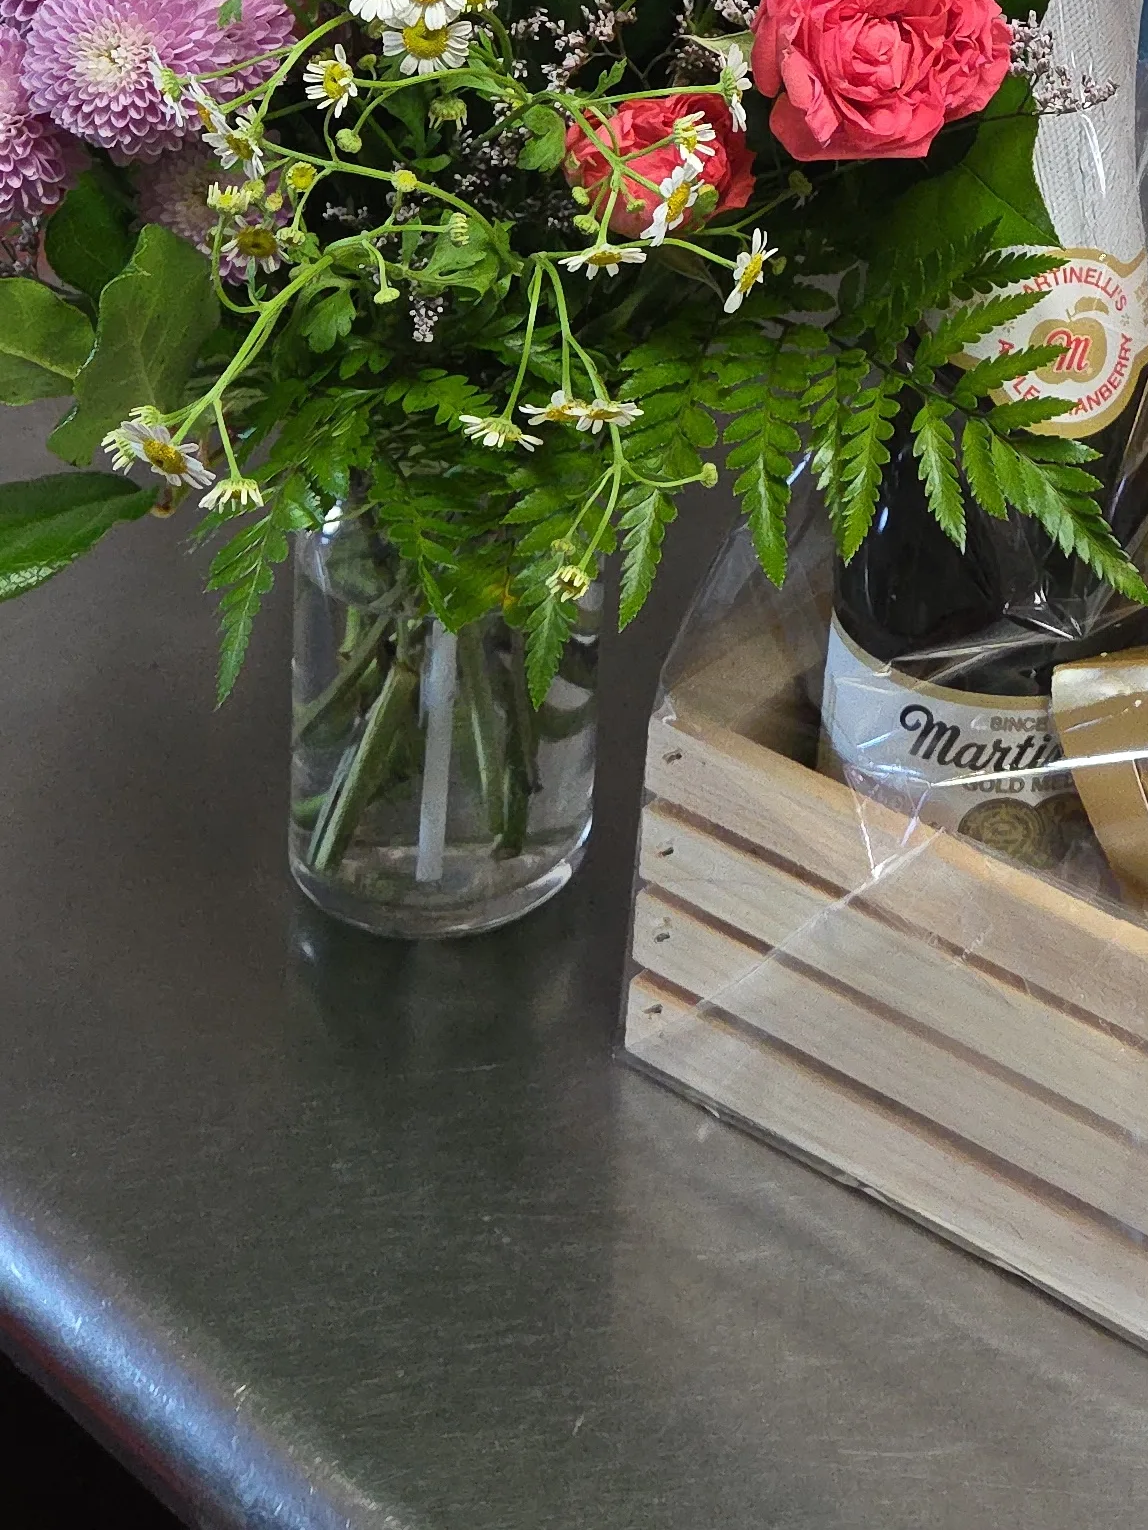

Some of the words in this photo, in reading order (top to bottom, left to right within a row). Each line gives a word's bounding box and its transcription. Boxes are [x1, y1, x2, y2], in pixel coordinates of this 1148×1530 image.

[1022, 266, 1127, 312] ARTINELLI'S
[997, 338, 1041, 401] ALE
[1070, 332, 1133, 416] ANBERRY
[962, 776, 1026, 794] GOLD
